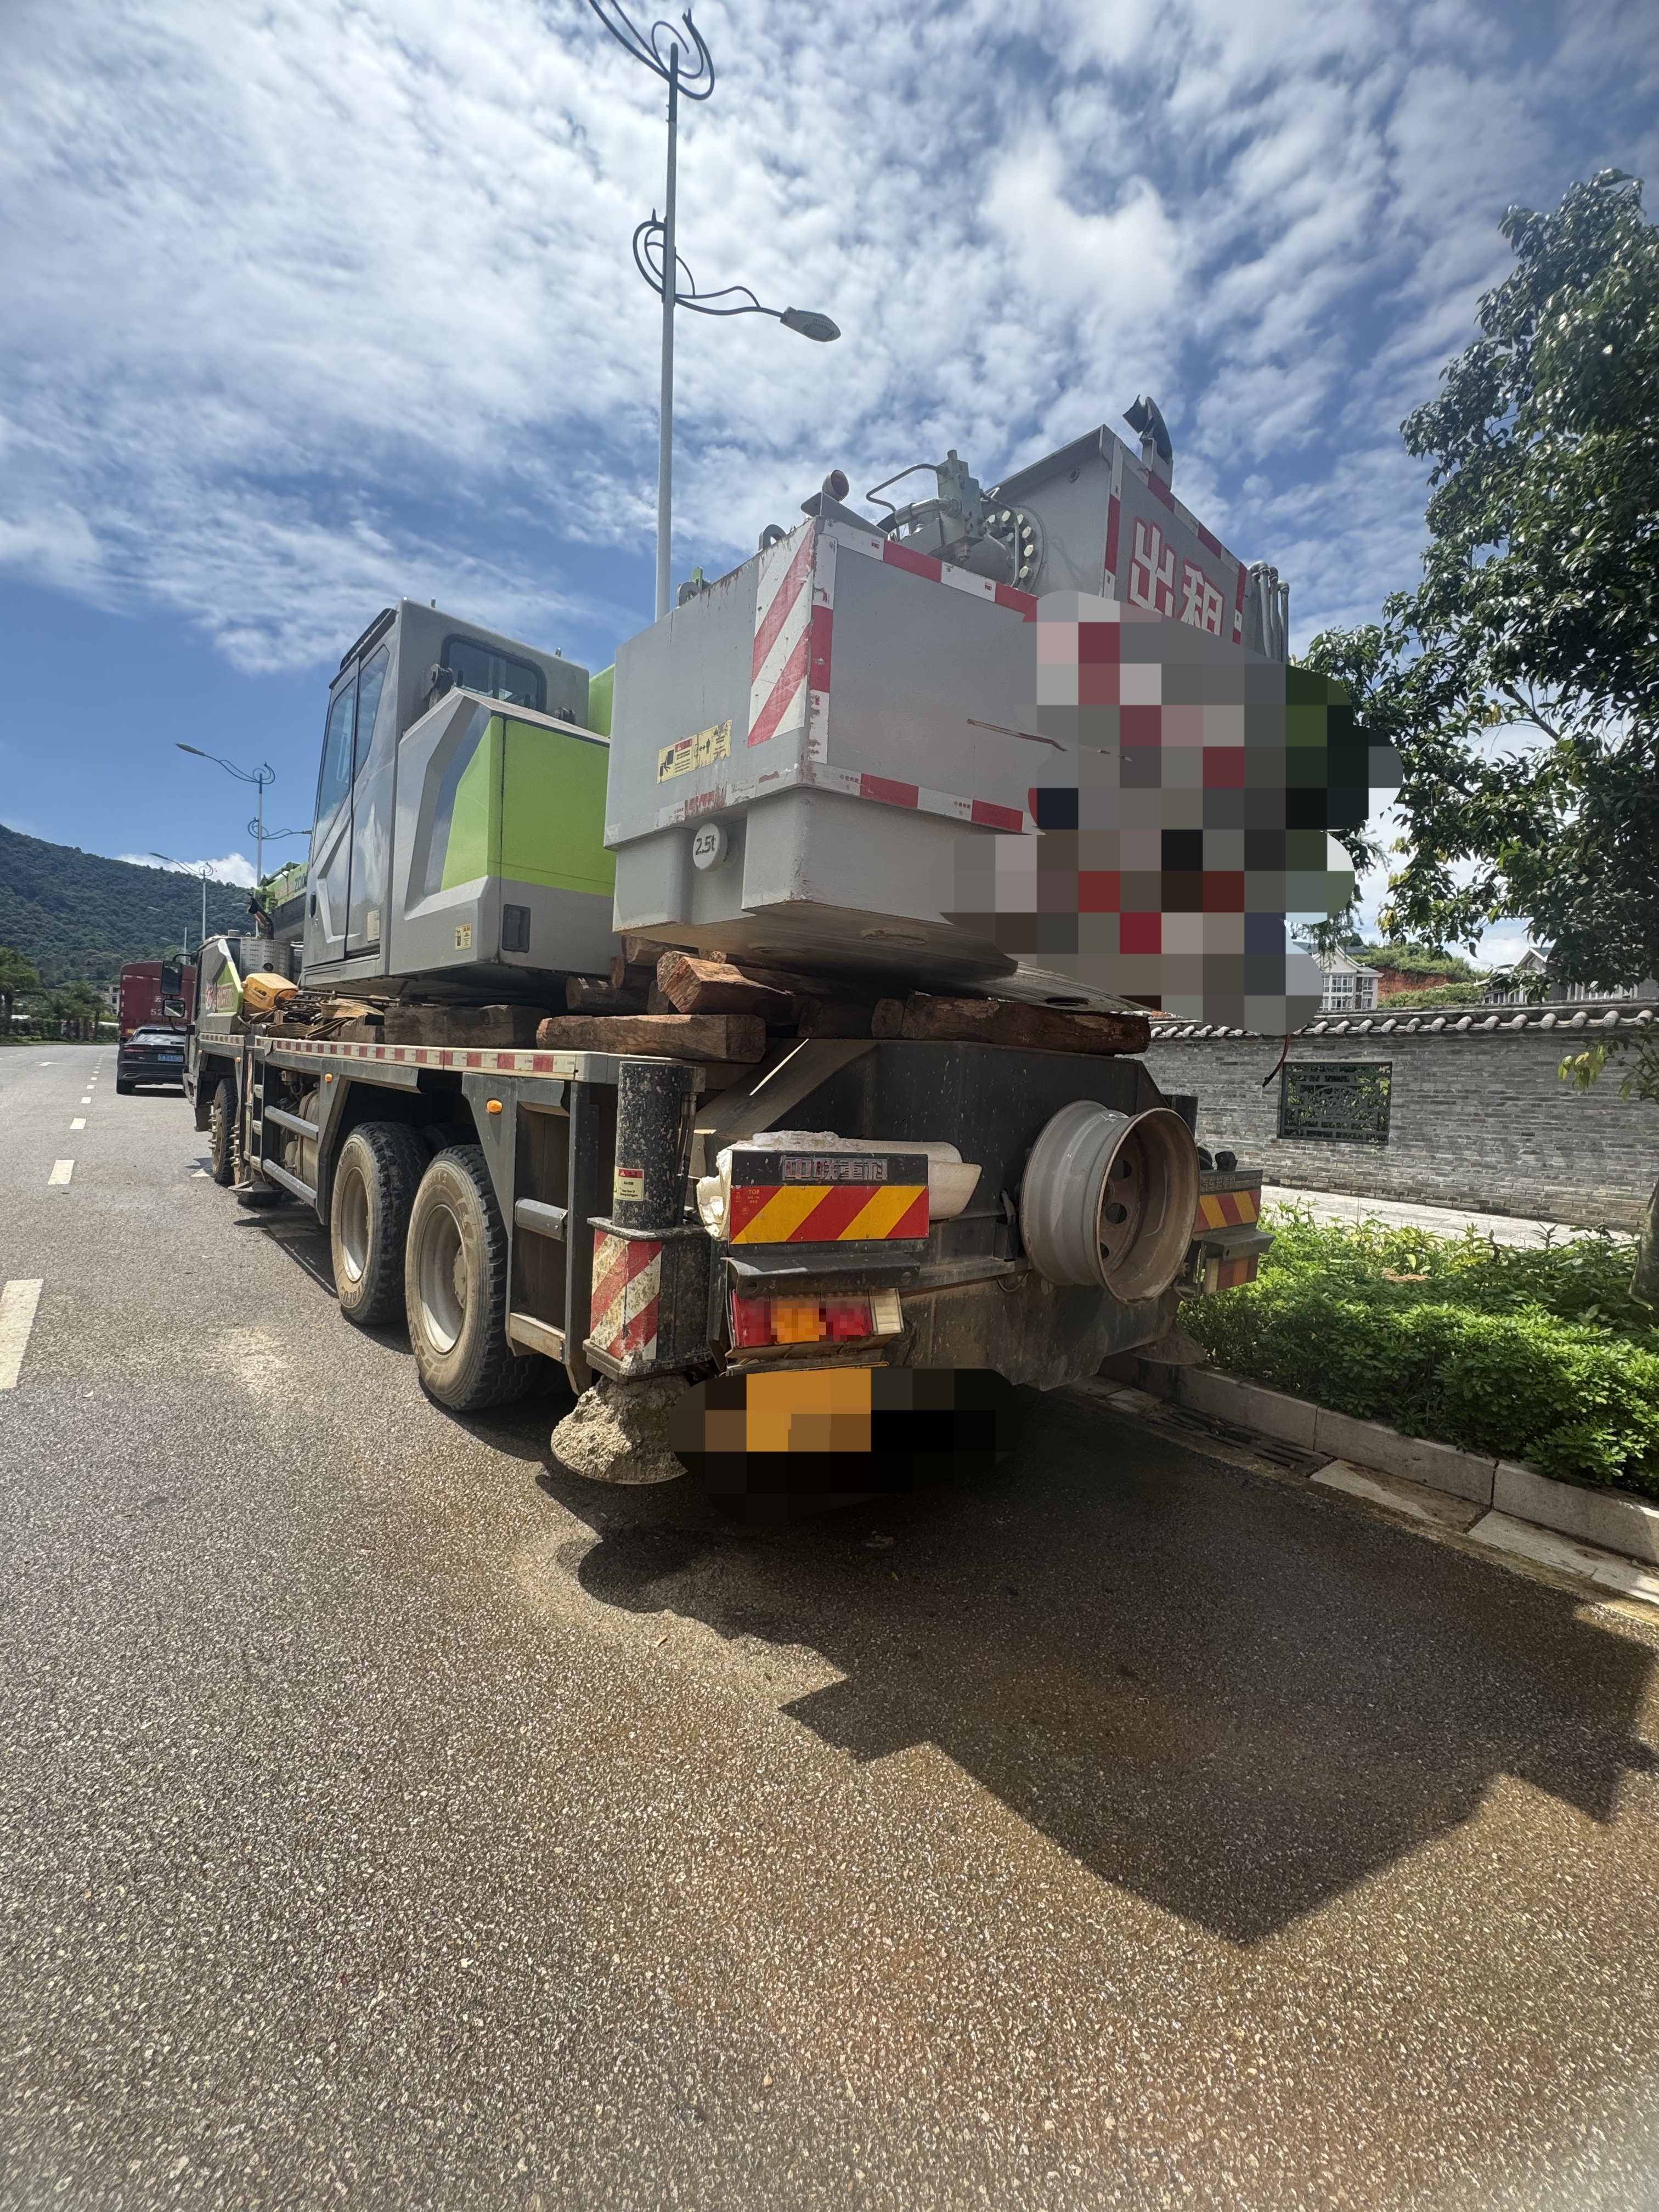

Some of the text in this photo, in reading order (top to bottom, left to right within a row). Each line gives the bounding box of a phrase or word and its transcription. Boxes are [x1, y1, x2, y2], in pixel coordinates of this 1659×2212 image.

[1129, 521, 1224, 637] 出租
[785, 1159, 888, 1180] 中联重科
